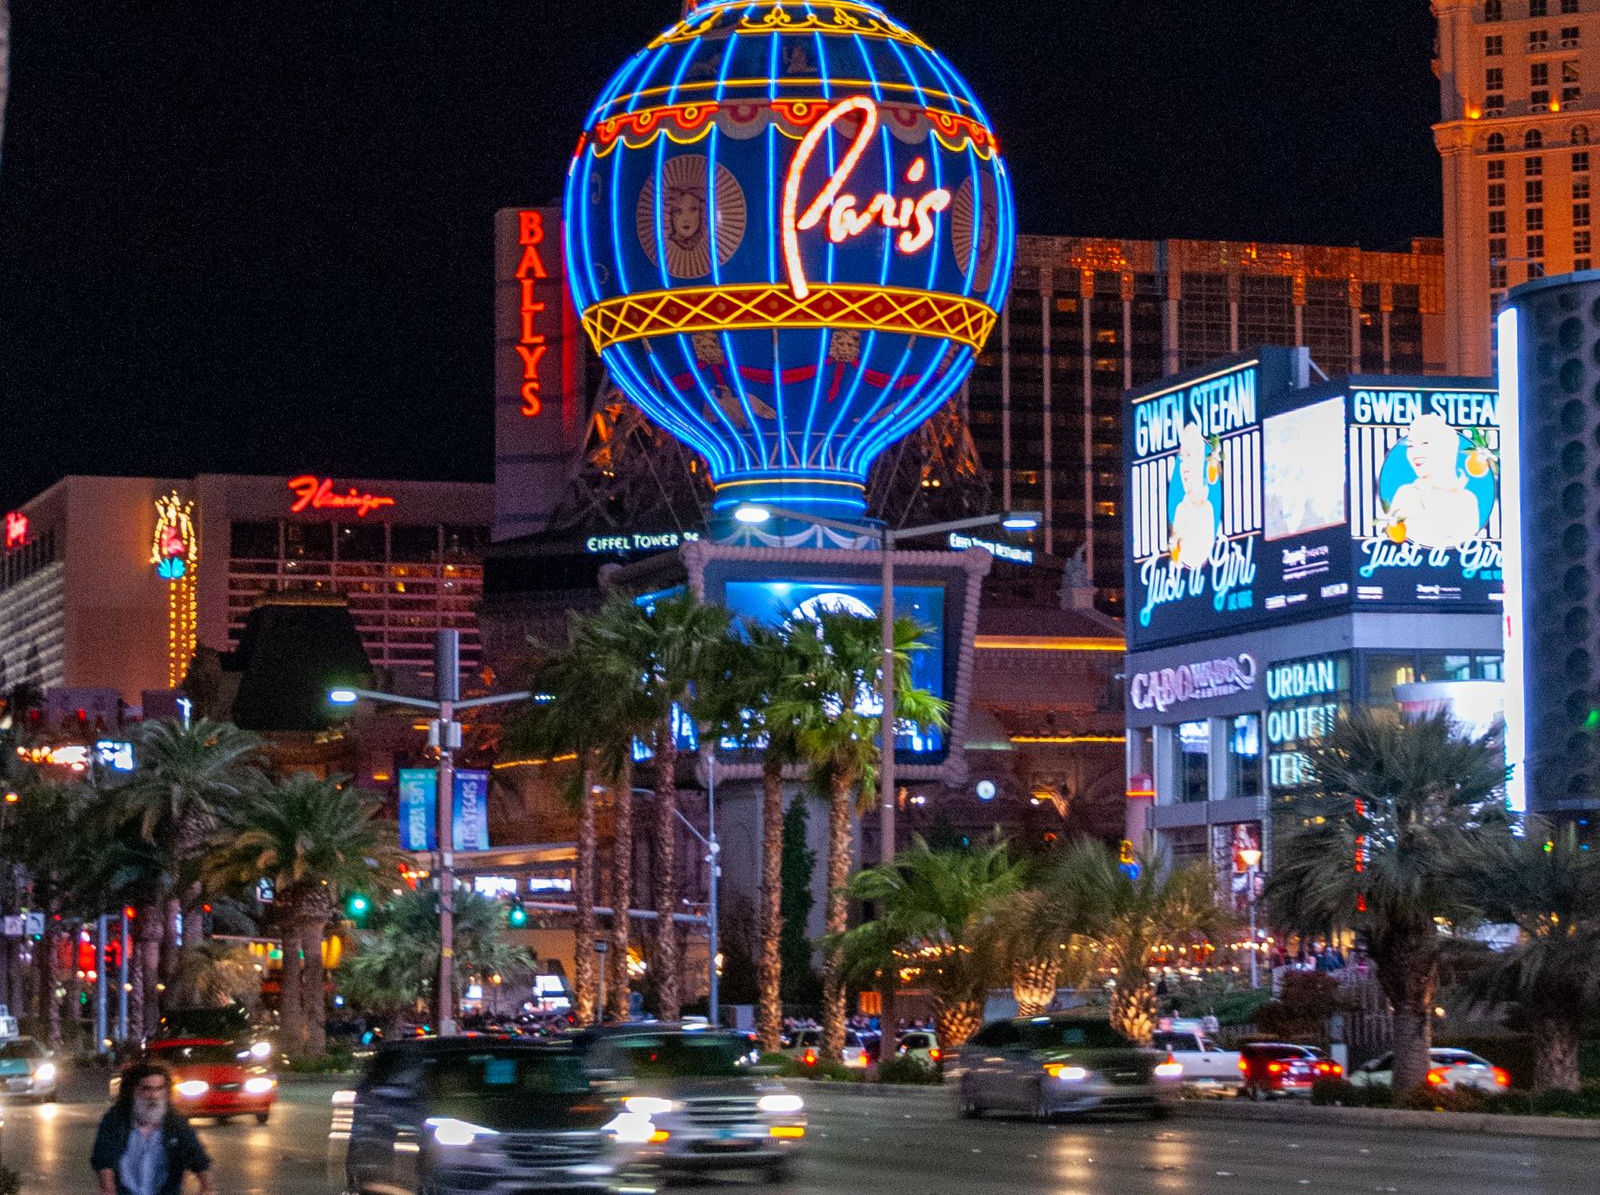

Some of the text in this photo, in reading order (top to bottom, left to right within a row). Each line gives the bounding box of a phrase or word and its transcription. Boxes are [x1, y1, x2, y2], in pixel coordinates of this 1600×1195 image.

[784, 96, 951, 299] Paris
[515, 210, 547, 417] BALLYS
[1134, 368, 1257, 457] GWEN STEFANI
[1353, 390, 1422, 424] GWEN
[288, 475, 395, 517] Flamingo
[587, 537, 631, 552] EIFFEL
[634, 533, 679, 549] TOWER
[1359, 537, 1425, 578] Just
[1140, 549, 1185, 627] Just
[1208, 534, 1256, 612] Girl
[1130, 665, 1194, 712] CABO
[1266, 660, 1336, 700] URBAN
